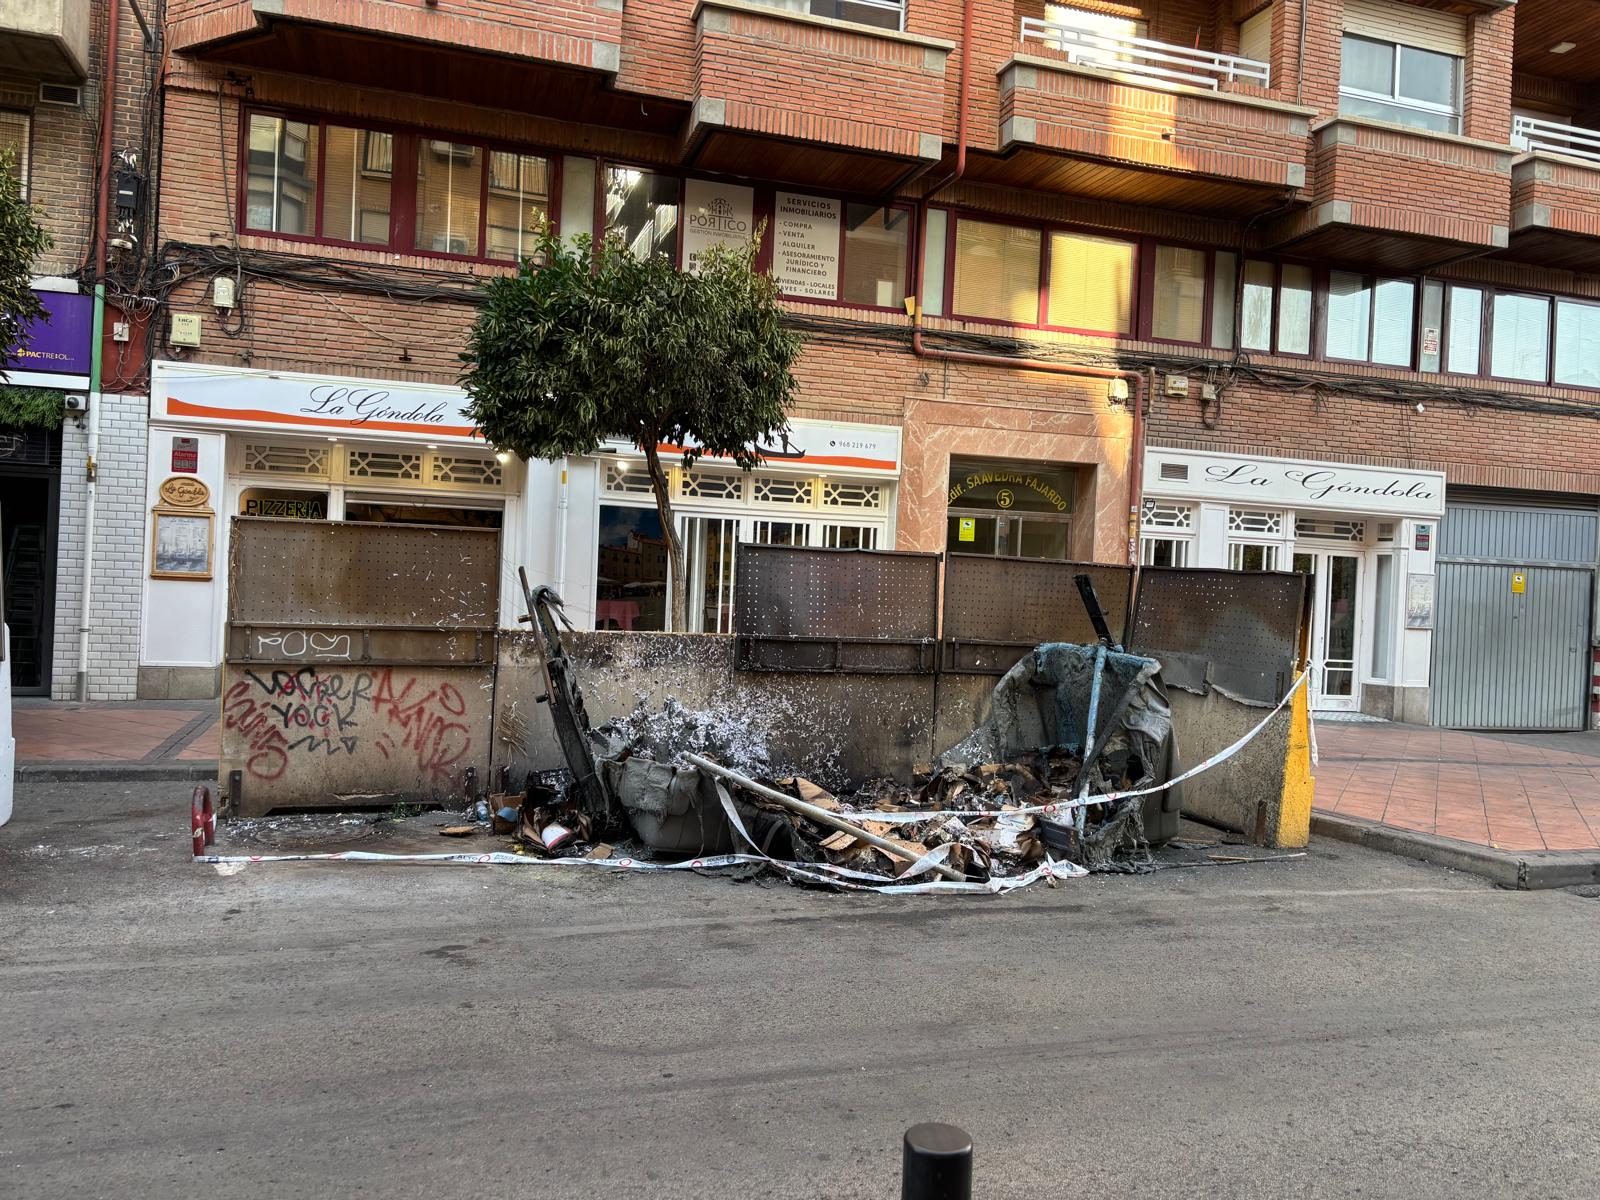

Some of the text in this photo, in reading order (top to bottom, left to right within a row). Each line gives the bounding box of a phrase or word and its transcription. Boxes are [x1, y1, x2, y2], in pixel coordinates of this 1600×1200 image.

[786, 198, 831, 210] SERVICIOS
[780, 205, 837, 219] INMOBILIARIOS
[783, 221, 813, 230] COMPRA
[782, 230, 805, 239] VENTA
[782, 241, 816, 250] ALQUILER
[781, 250, 836, 262] ASESORAMIENTO
[785, 258, 819, 268] JURÍDICO
[785, 266, 827, 277] FINANCIERO
[776, 278, 835, 290] IVIENDAS LOCALES
[777, 284, 835, 297] AVES SOLARES
[299, 385, 449, 426] La Góndola
[1204, 464, 1437, 500] La Góndola
[966, 470, 1023, 490] SAAVEDRA
[1024, 475, 1068, 512] FAJARDO
[1000, 491, 1011, 507] 5
[246, 499, 322, 518] PIZZERIA
